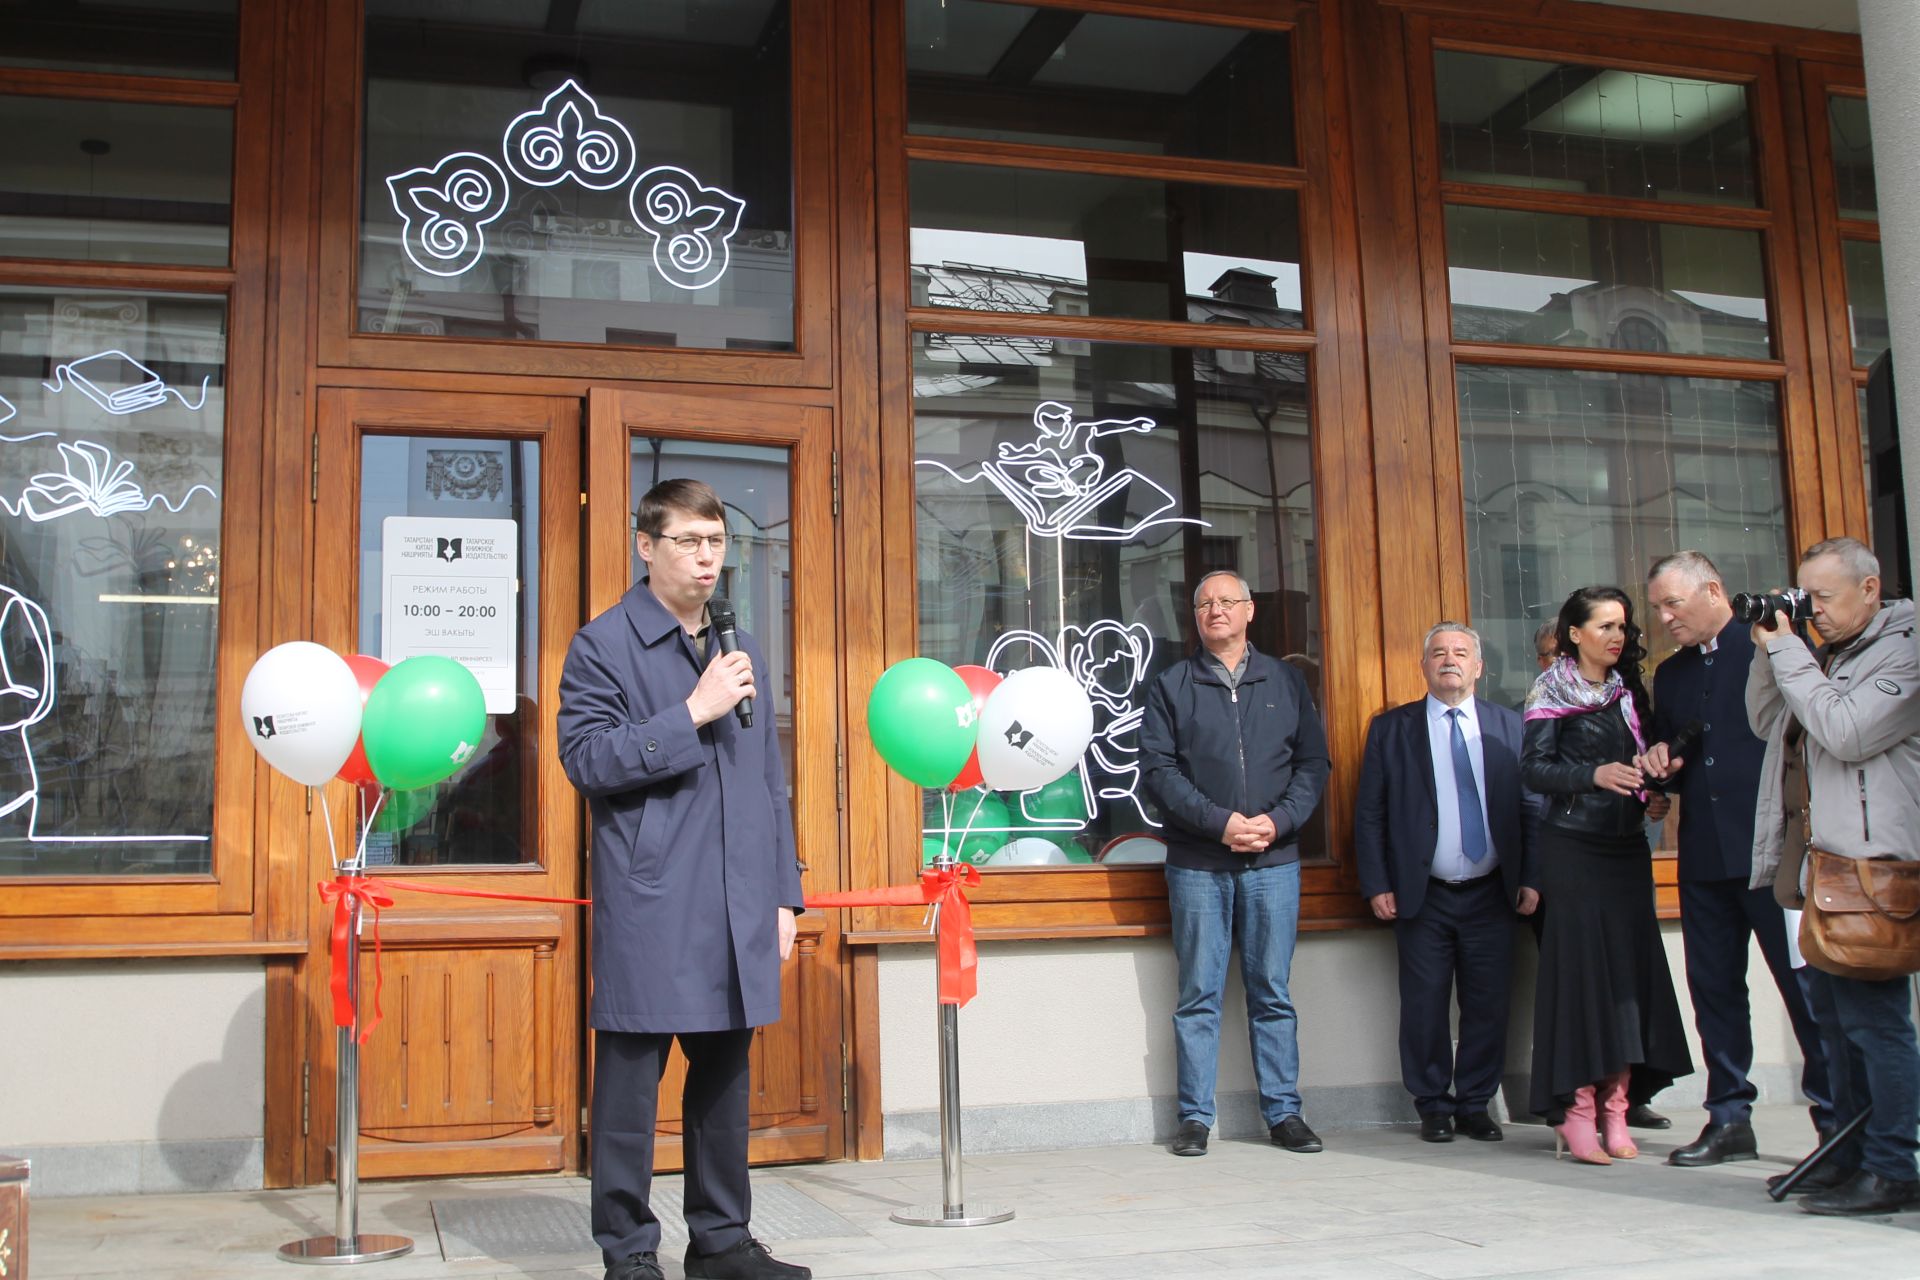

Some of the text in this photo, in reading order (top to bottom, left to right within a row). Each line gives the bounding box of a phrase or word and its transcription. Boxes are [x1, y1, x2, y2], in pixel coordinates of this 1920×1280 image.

[412, 585, 488, 595] РЕЖИМ РАБОТЫ
[403, 604, 441, 617] 10:00
[458, 605, 496, 618] 20:00
[441, 629, 475, 637] ВАКЫТЫ
